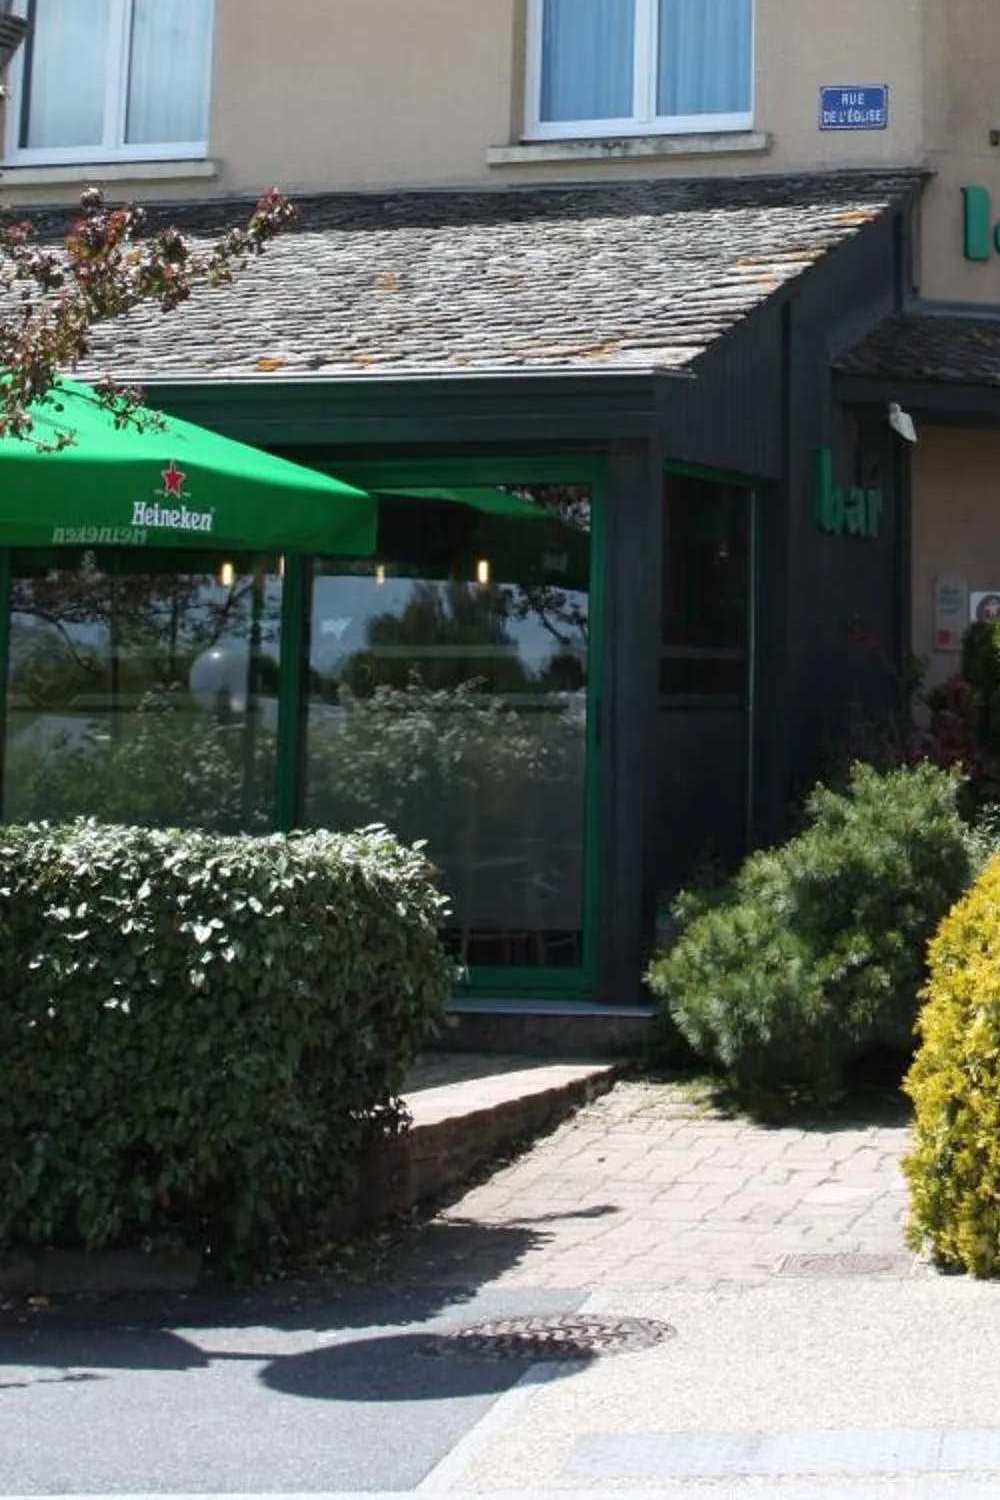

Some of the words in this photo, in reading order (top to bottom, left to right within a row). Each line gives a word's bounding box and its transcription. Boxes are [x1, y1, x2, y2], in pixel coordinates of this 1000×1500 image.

[841, 93, 865, 105] RUE
[823, 110, 837, 124] DE
[815, 447, 883, 538] bar
[131, 501, 214, 531] Heineken
